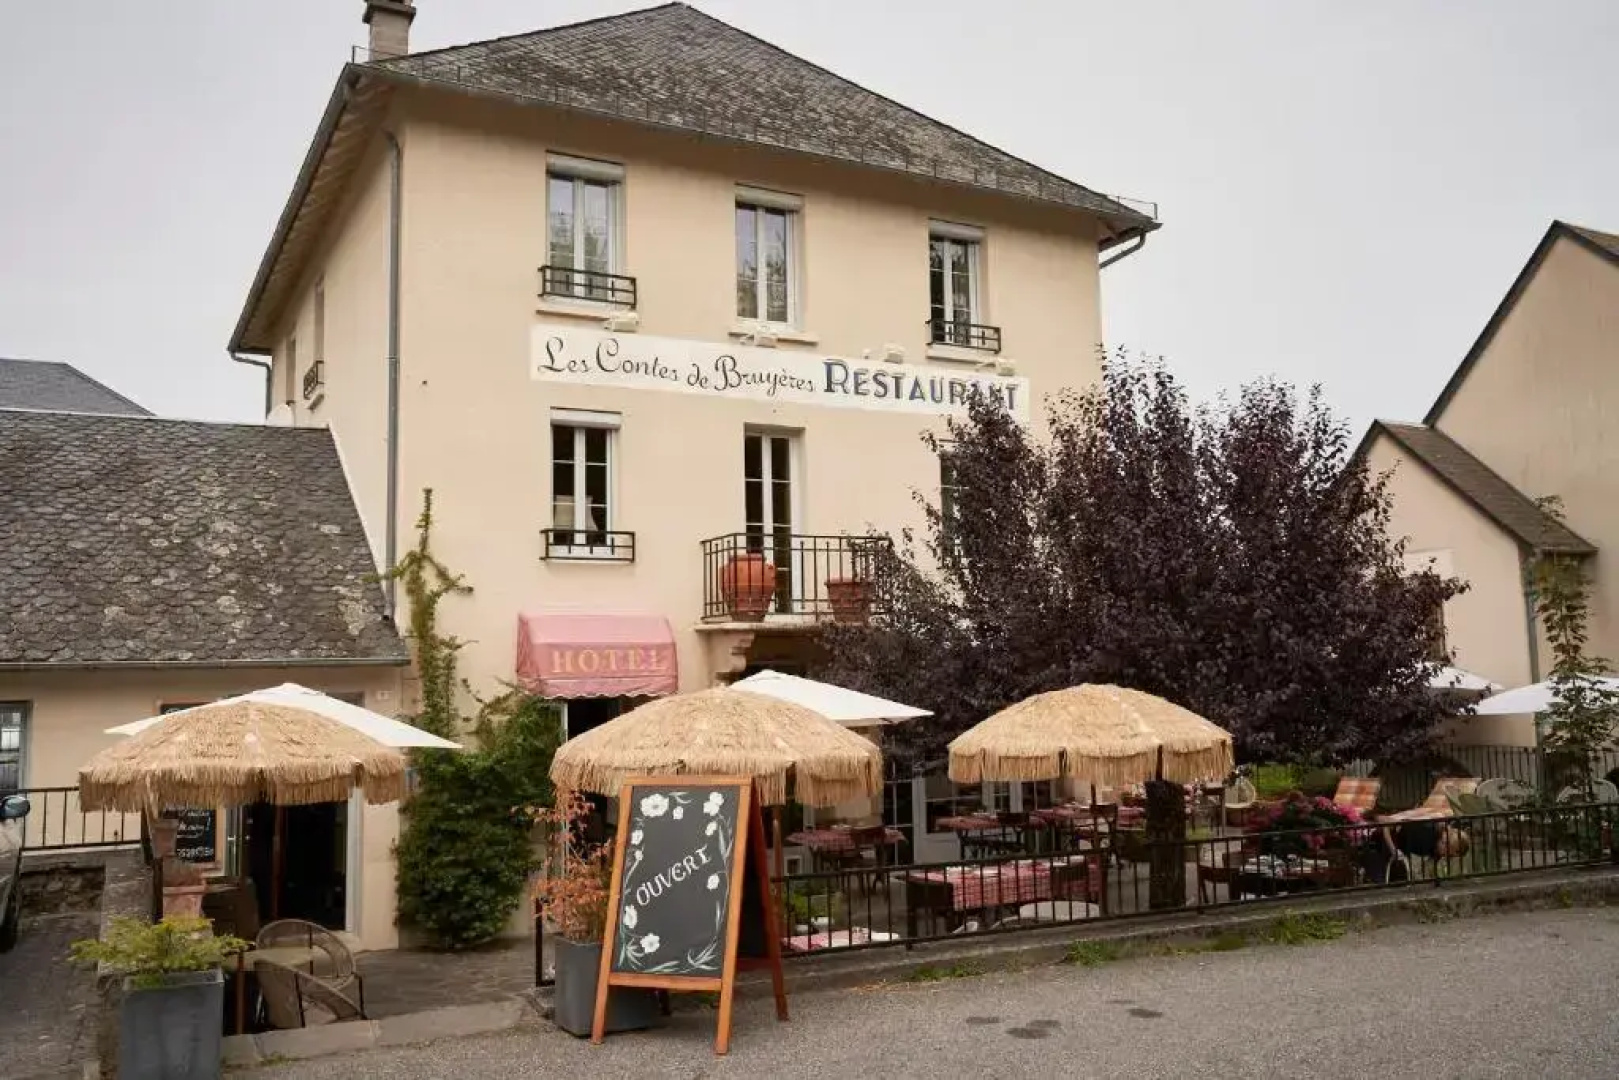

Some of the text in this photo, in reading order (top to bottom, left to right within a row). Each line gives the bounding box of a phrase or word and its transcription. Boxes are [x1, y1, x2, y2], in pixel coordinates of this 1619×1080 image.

[537, 336, 590, 373] Les
[595, 337, 678, 381] Contes
[687, 363, 708, 389] de
[714, 353, 815, 397] Bruyères
[636, 845, 711, 906] OUVERT
